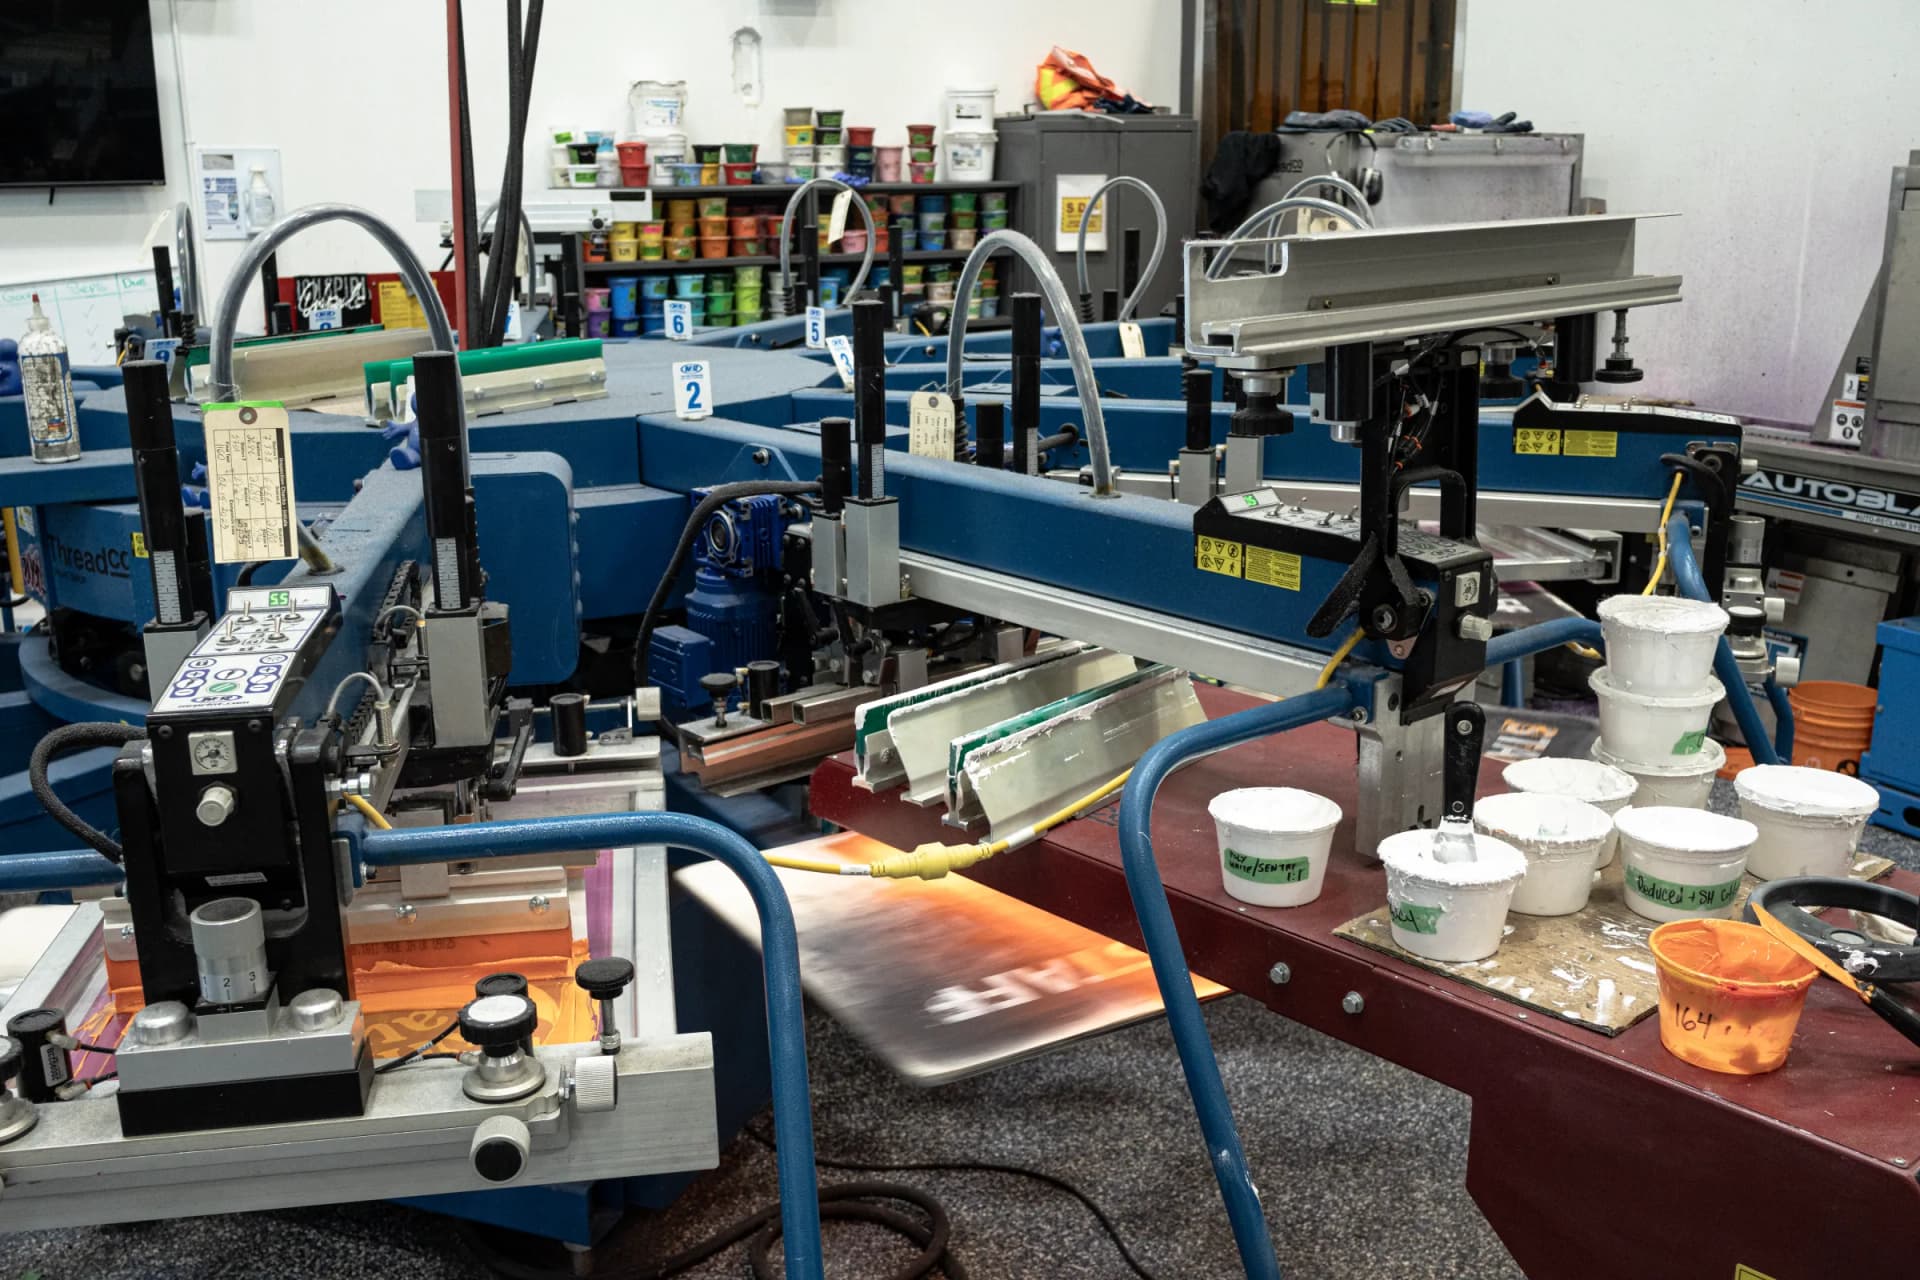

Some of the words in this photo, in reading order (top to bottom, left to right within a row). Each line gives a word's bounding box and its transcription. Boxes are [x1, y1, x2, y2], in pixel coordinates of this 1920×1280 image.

[1066, 202, 1074, 213] S
[672, 314, 684, 334] 6
[811, 322, 820, 342] 5
[686, 381, 702, 410] 2
[223, 978, 231, 988] 2
[248, 971, 257, 982] 3
[1674, 1002, 1712, 1040] 164
